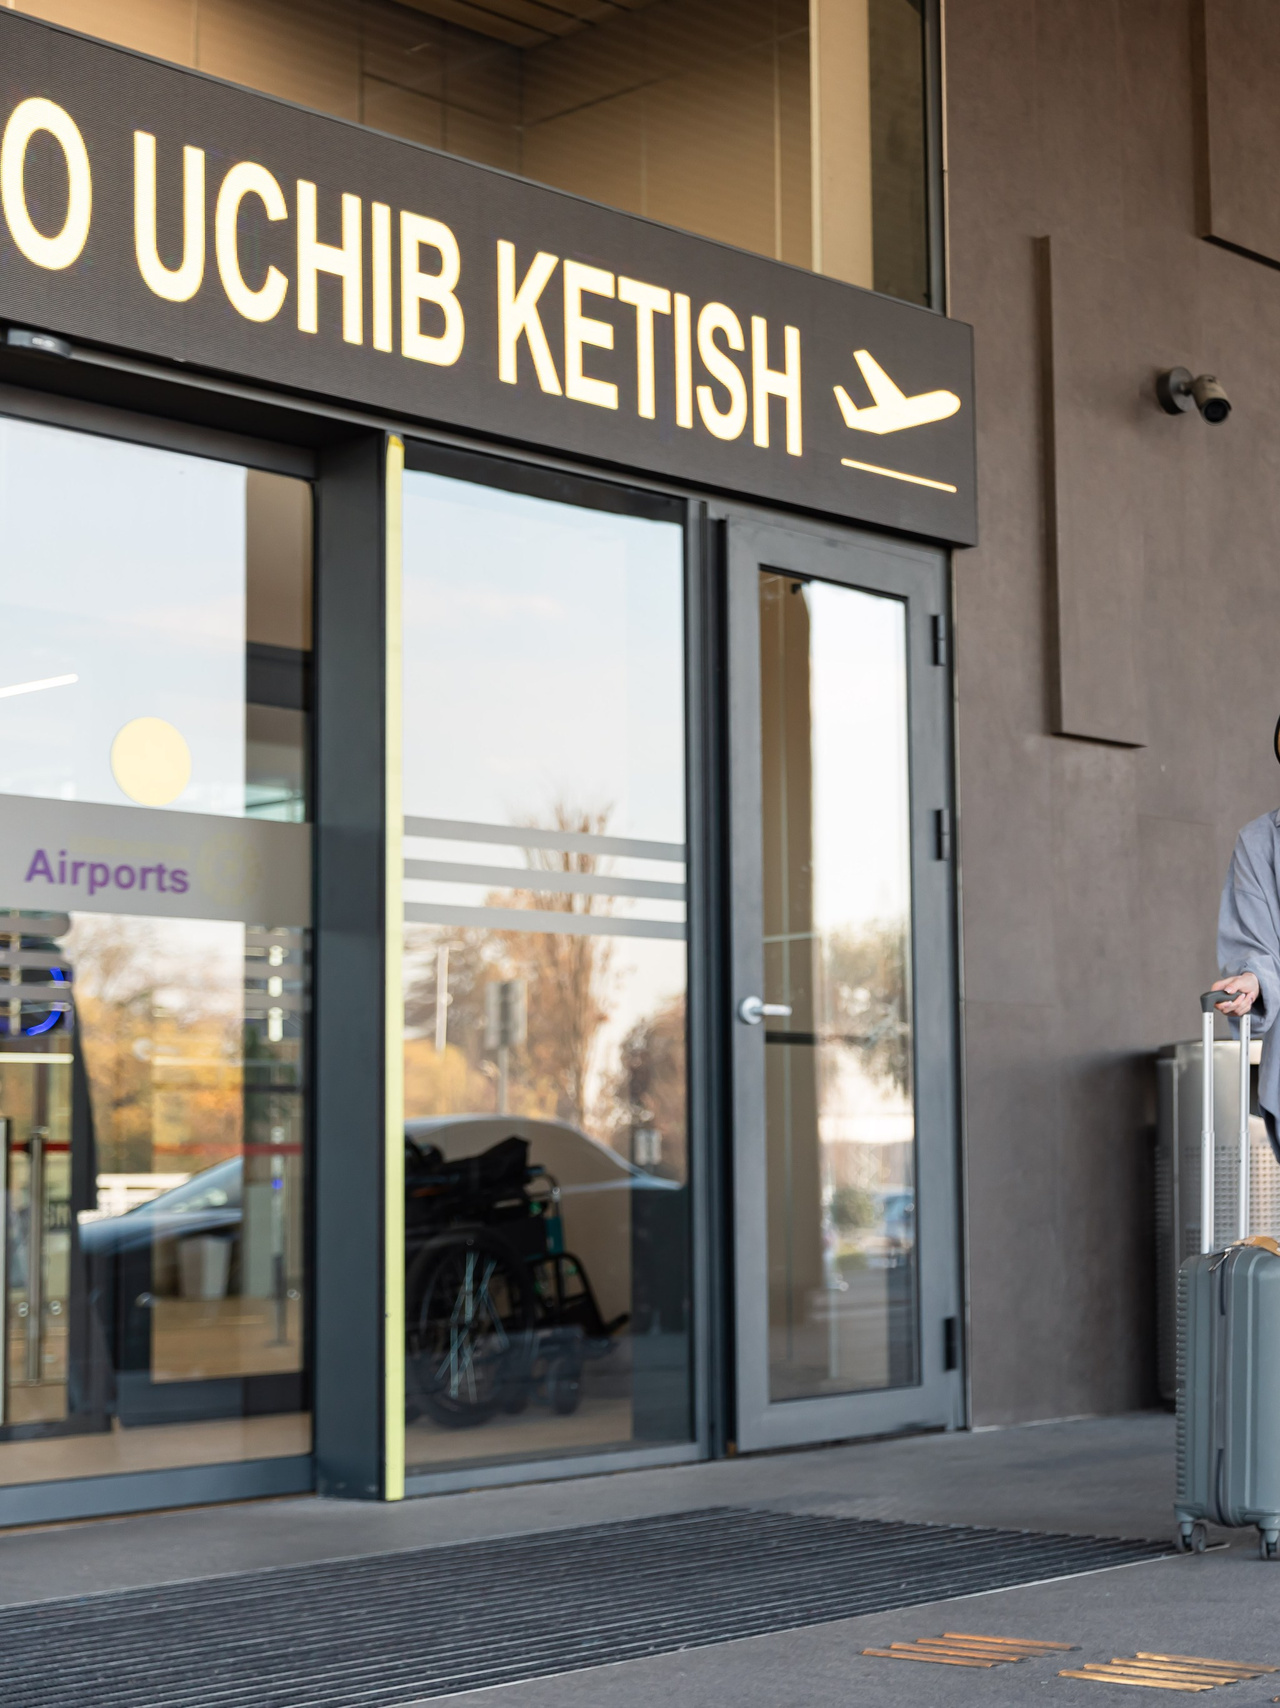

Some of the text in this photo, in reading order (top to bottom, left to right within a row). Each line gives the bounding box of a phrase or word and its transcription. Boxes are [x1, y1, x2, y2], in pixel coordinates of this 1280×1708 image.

[133, 130, 465, 367] UCHIB
[496, 239, 803, 457] KETISH
[24, 848, 191, 896] Airports
